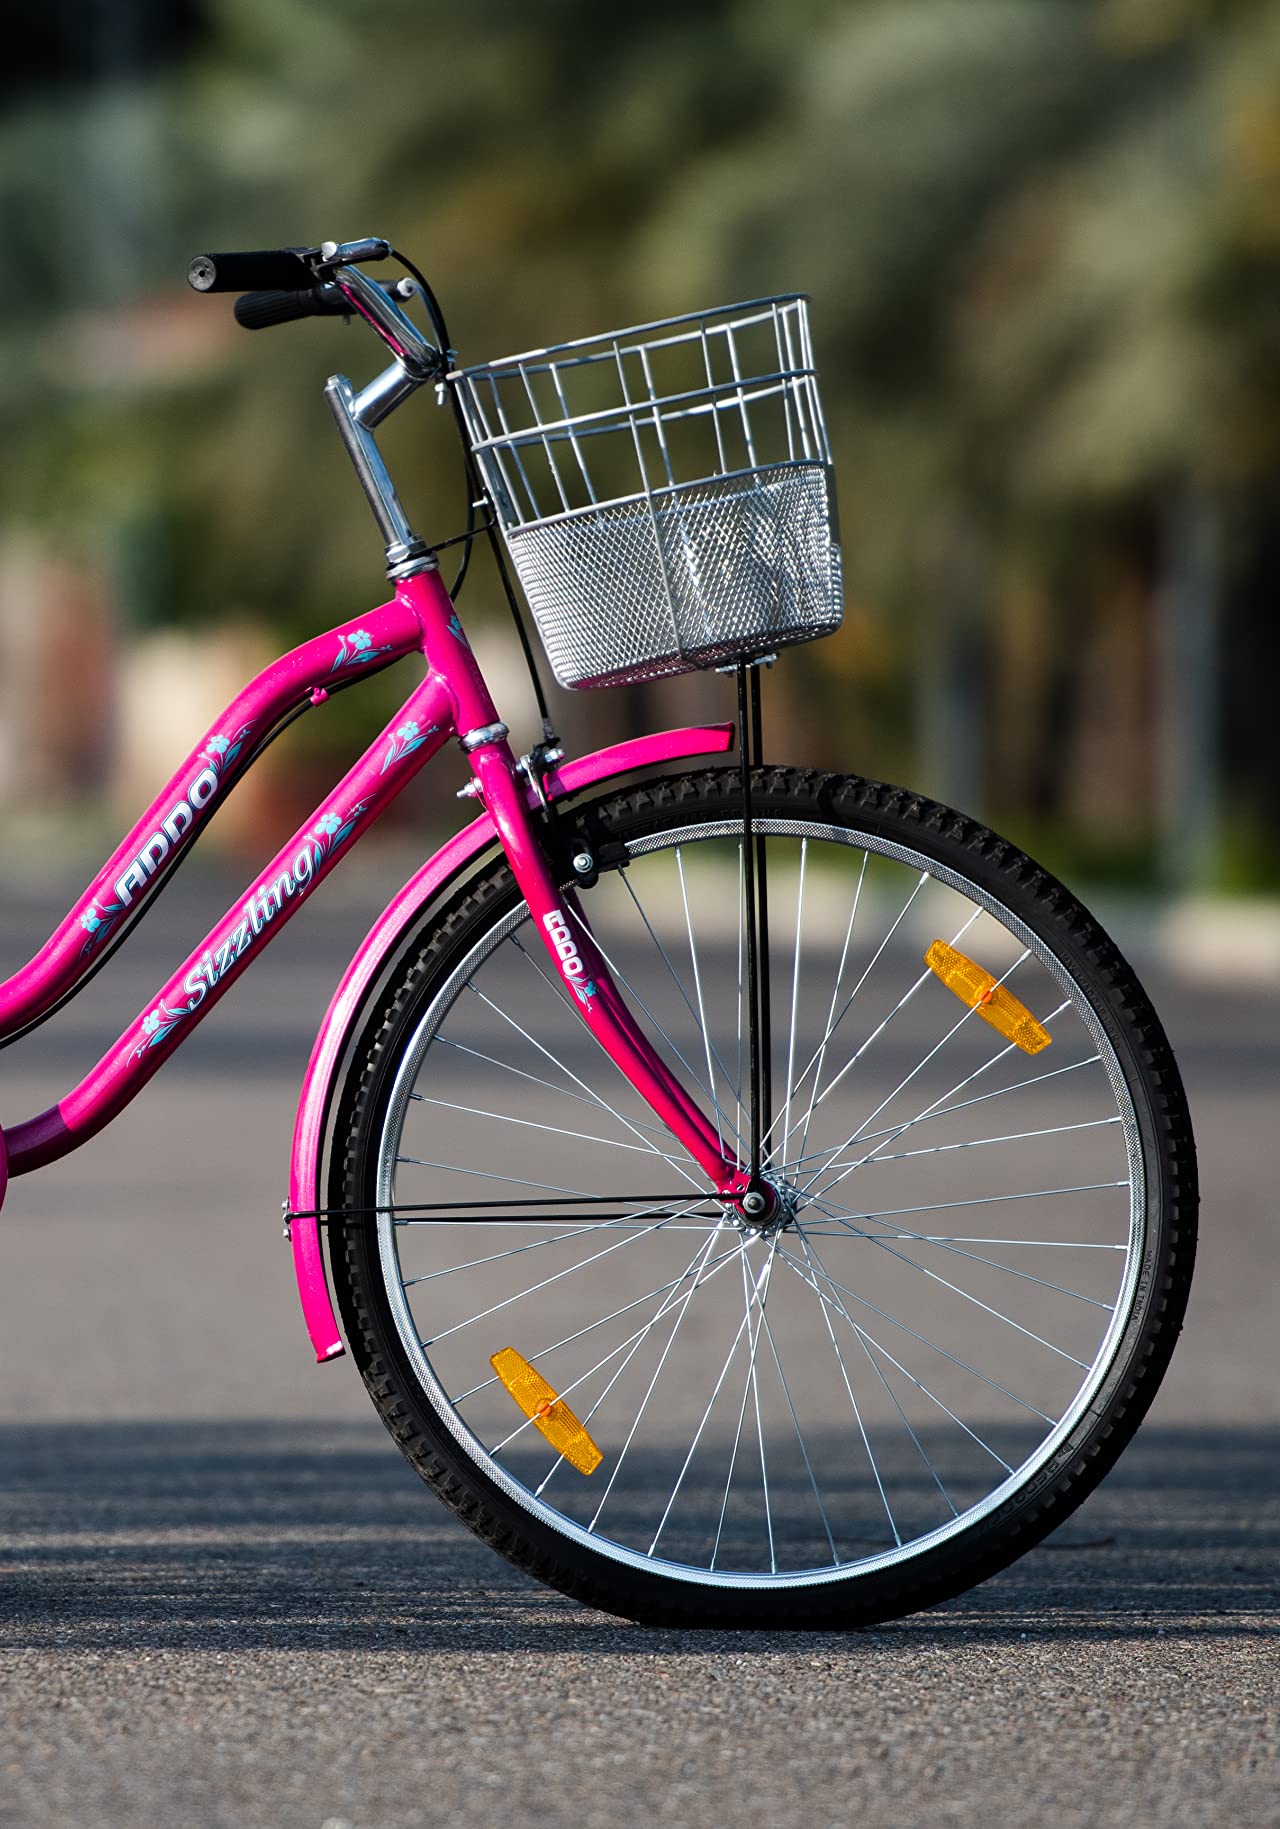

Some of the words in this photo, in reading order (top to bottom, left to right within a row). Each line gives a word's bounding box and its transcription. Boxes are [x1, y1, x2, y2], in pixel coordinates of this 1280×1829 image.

[114, 767, 219, 908] ADDO
[183, 844, 314, 1012] Sizzling
[542, 909, 584, 976] ADDO
[1143, 1249, 1153, 1275] MADE
[1132, 1294, 1145, 1320] INDIA
[1139, 1280, 1148, 1291] IN
